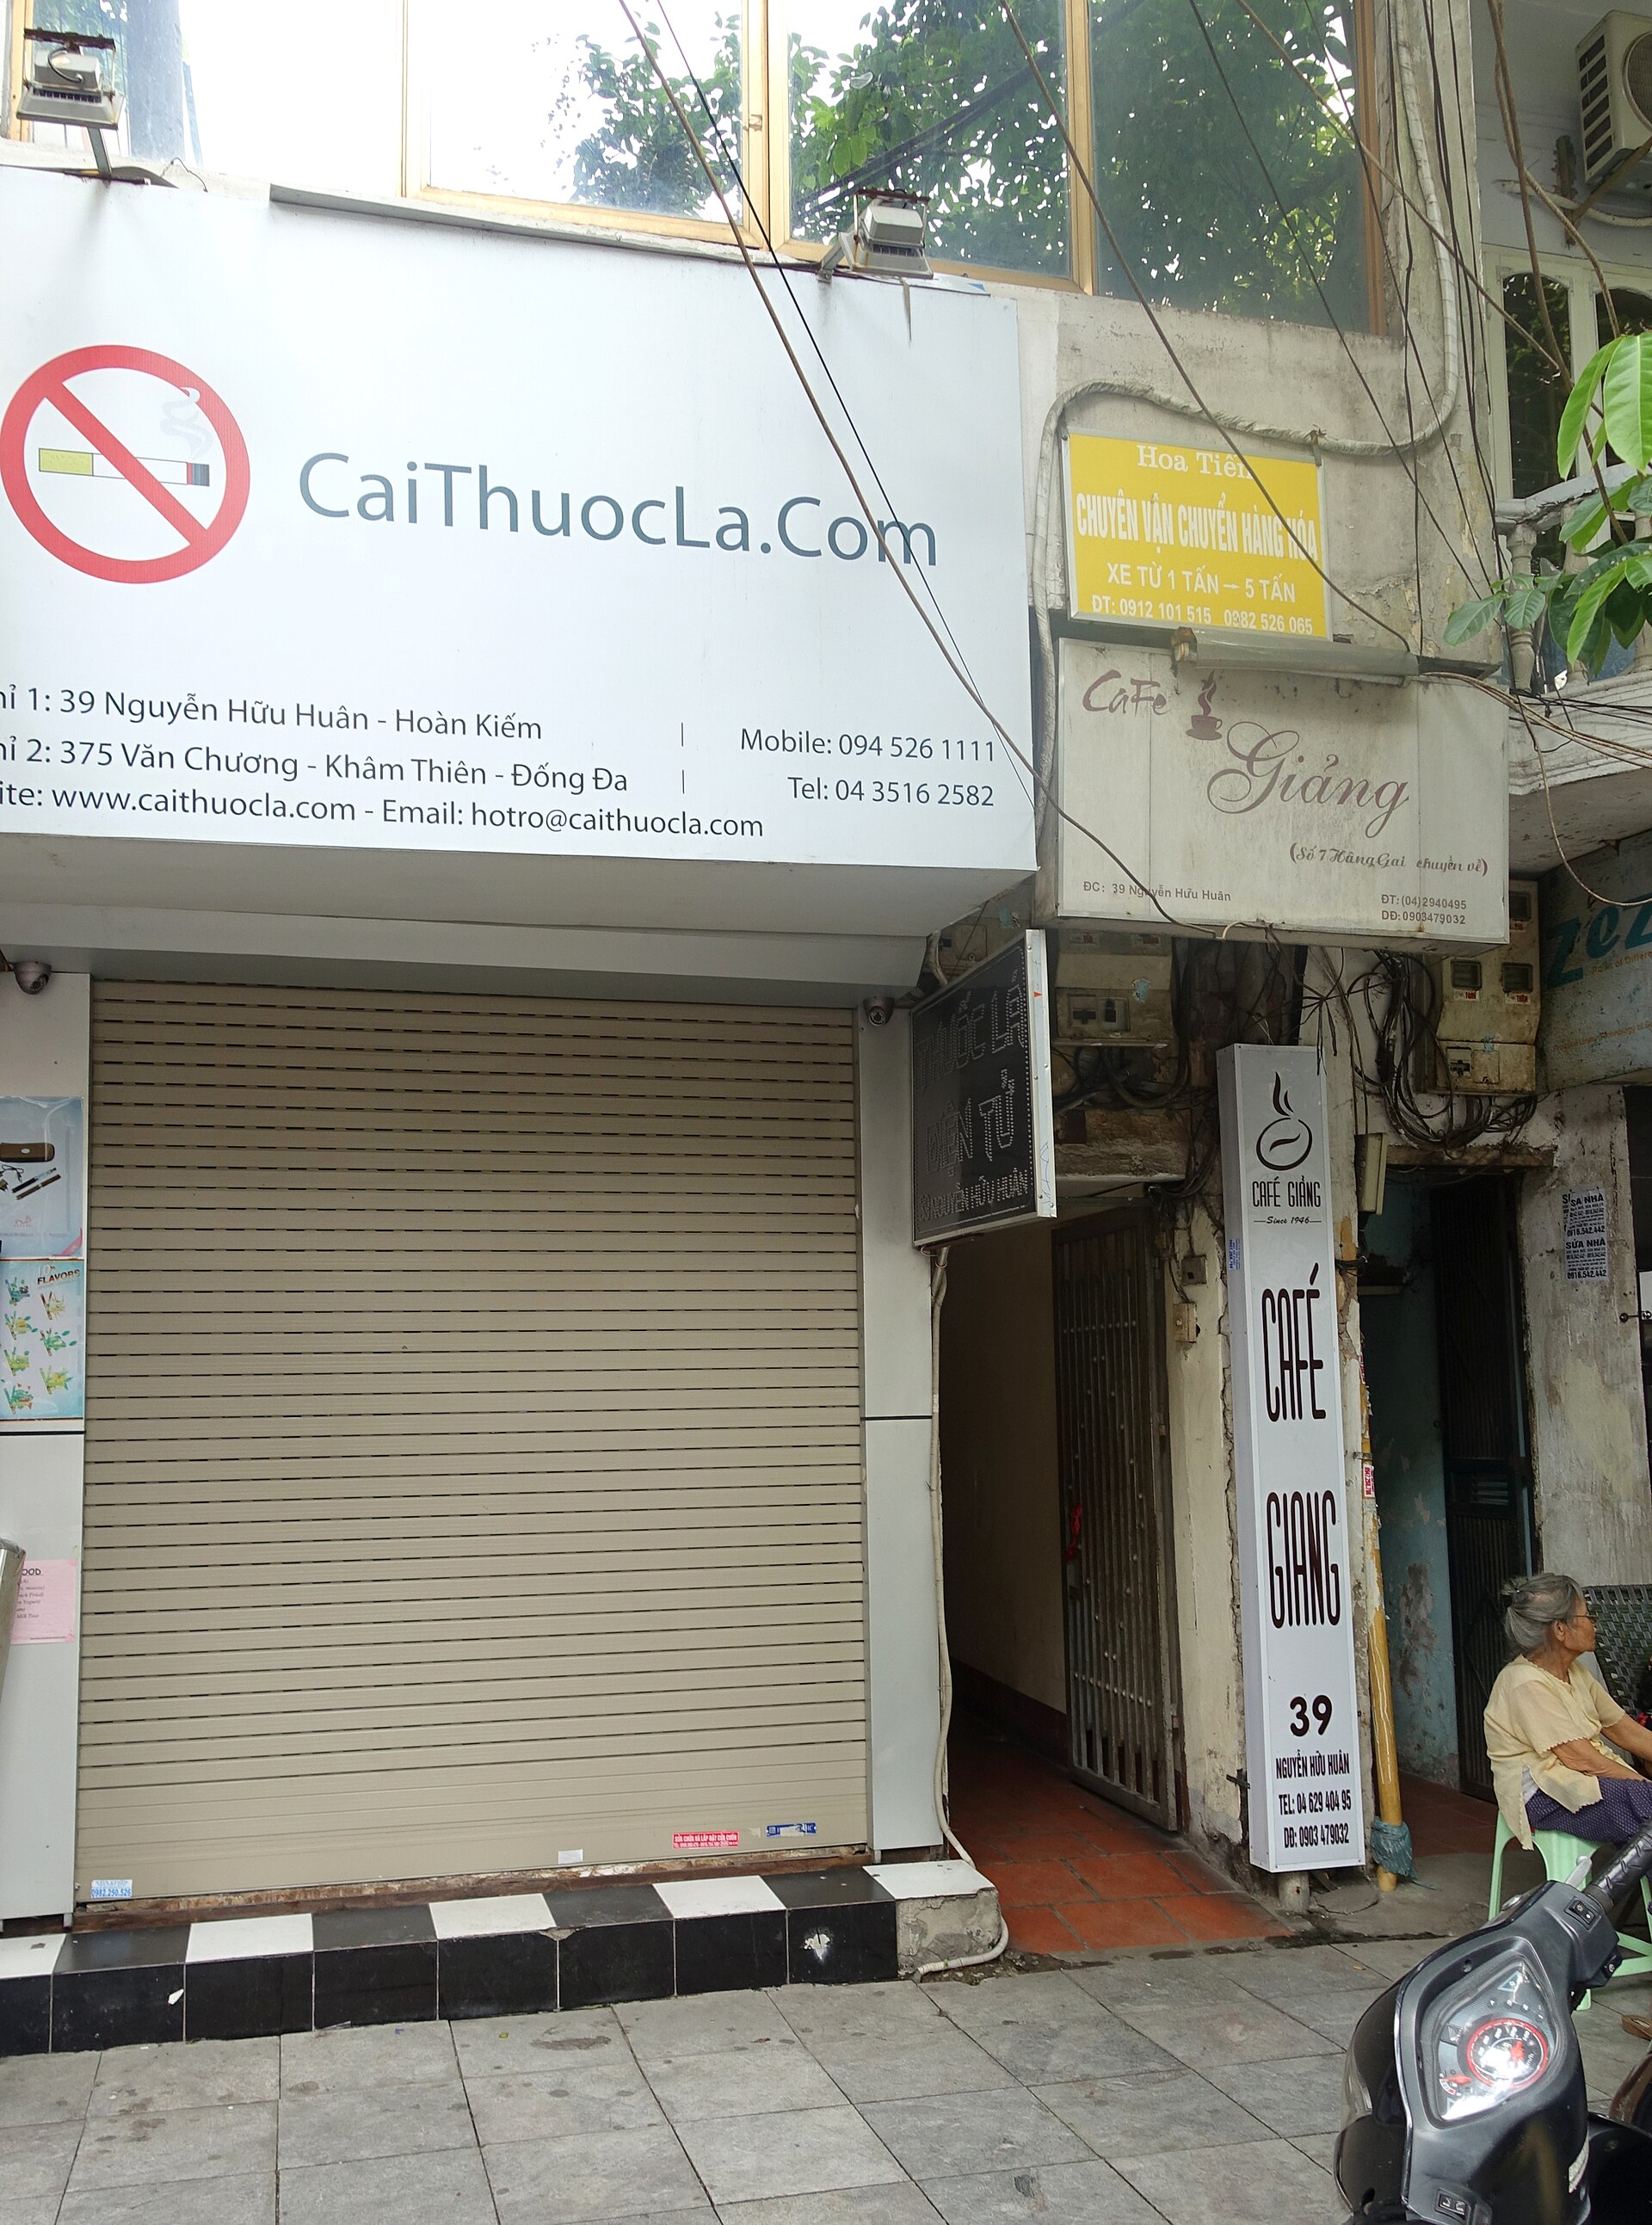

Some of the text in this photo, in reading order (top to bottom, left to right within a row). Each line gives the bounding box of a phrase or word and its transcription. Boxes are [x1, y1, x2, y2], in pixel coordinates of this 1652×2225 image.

[1137, 445, 1188, 472] Hoa
[299, 452, 938, 568] CaiThuocLa.Com
[1076, 489, 1138, 541] CHUYÊN
[1142, 493, 1174, 553] VẬN
[1178, 492, 1238, 552] CHUYỂN
[1242, 504, 1284, 558] HÀNG
[1107, 562, 1295, 602] XE TỪ 1 TẤN 5 TẤN
[1092, 595, 1115, 614] ĐT:
[1119, 601, 1153, 619] 0912
[1159, 604, 1181, 621] 101
[1187, 607, 1211, 625] 515
[1261, 613, 1285, 632] 526
[1289, 616, 1313, 635] 065
[28, 688, 50, 712] 1:
[61, 690, 94, 713] 39
[106, 692, 217, 725] Nguyễn
[229, 700, 285, 724] Hữu
[297, 704, 367, 730] Huân
[397, 710, 465, 735] Hoàn
[478, 713, 540, 739] Kiếm
[742, 729, 992, 761] Mobile: 094 526 1111
[27, 739, 50, 762] 2:
[61, 741, 112, 766] 375
[121, 743, 174, 768] Văn
[185, 747, 297, 781] Chương
[327, 755, 403, 780] Khâm
[411, 759, 485, 784] Thiên
[511, 762, 583, 795] Đống
[593, 768, 626, 791] Đa
[1207, 721, 1410, 839] Giảng
[787, 777, 993, 806] Tel: 04 3516 2582
[52, 789, 354, 820] www.caithuocla.com
[384, 799, 462, 824] Email:
[472, 802, 762, 836] hotro@caithuocla.com
[1083, 880, 1106, 893] ĐC:
[1112, 884, 1125, 895] 39
[1175, 887, 1199, 900] Hữu
[1202, 889, 1232, 902] Huân
[1381, 894, 1399, 905] ĐT:
[1381, 910, 1466, 925] DĐ: 0903479032
[1252, 1174, 1322, 1208] CAFÉ GIẢNG
[1584, 1193, 1604, 1204] NHÀ
[1266, 1216, 1310, 1225] Since 1946
[1565, 1237, 1606, 1249] SỬA NHÀ
[37, 1269, 81, 1285] FLAVORS
[1261, 1262, 1326, 1422] CAFÉ
[1267, 1490, 1341, 1629] GIANG
[1290, 1694, 1333, 1737] 39
[1276, 1749, 1350, 1779] NGUYỄN HỮU HUÂN
[1279, 1790, 1352, 1815] TEL: 04 629 404 95
[1299, 1825, 1318, 1846] 0903
[1321, 1823, 1349, 1845] 479032
